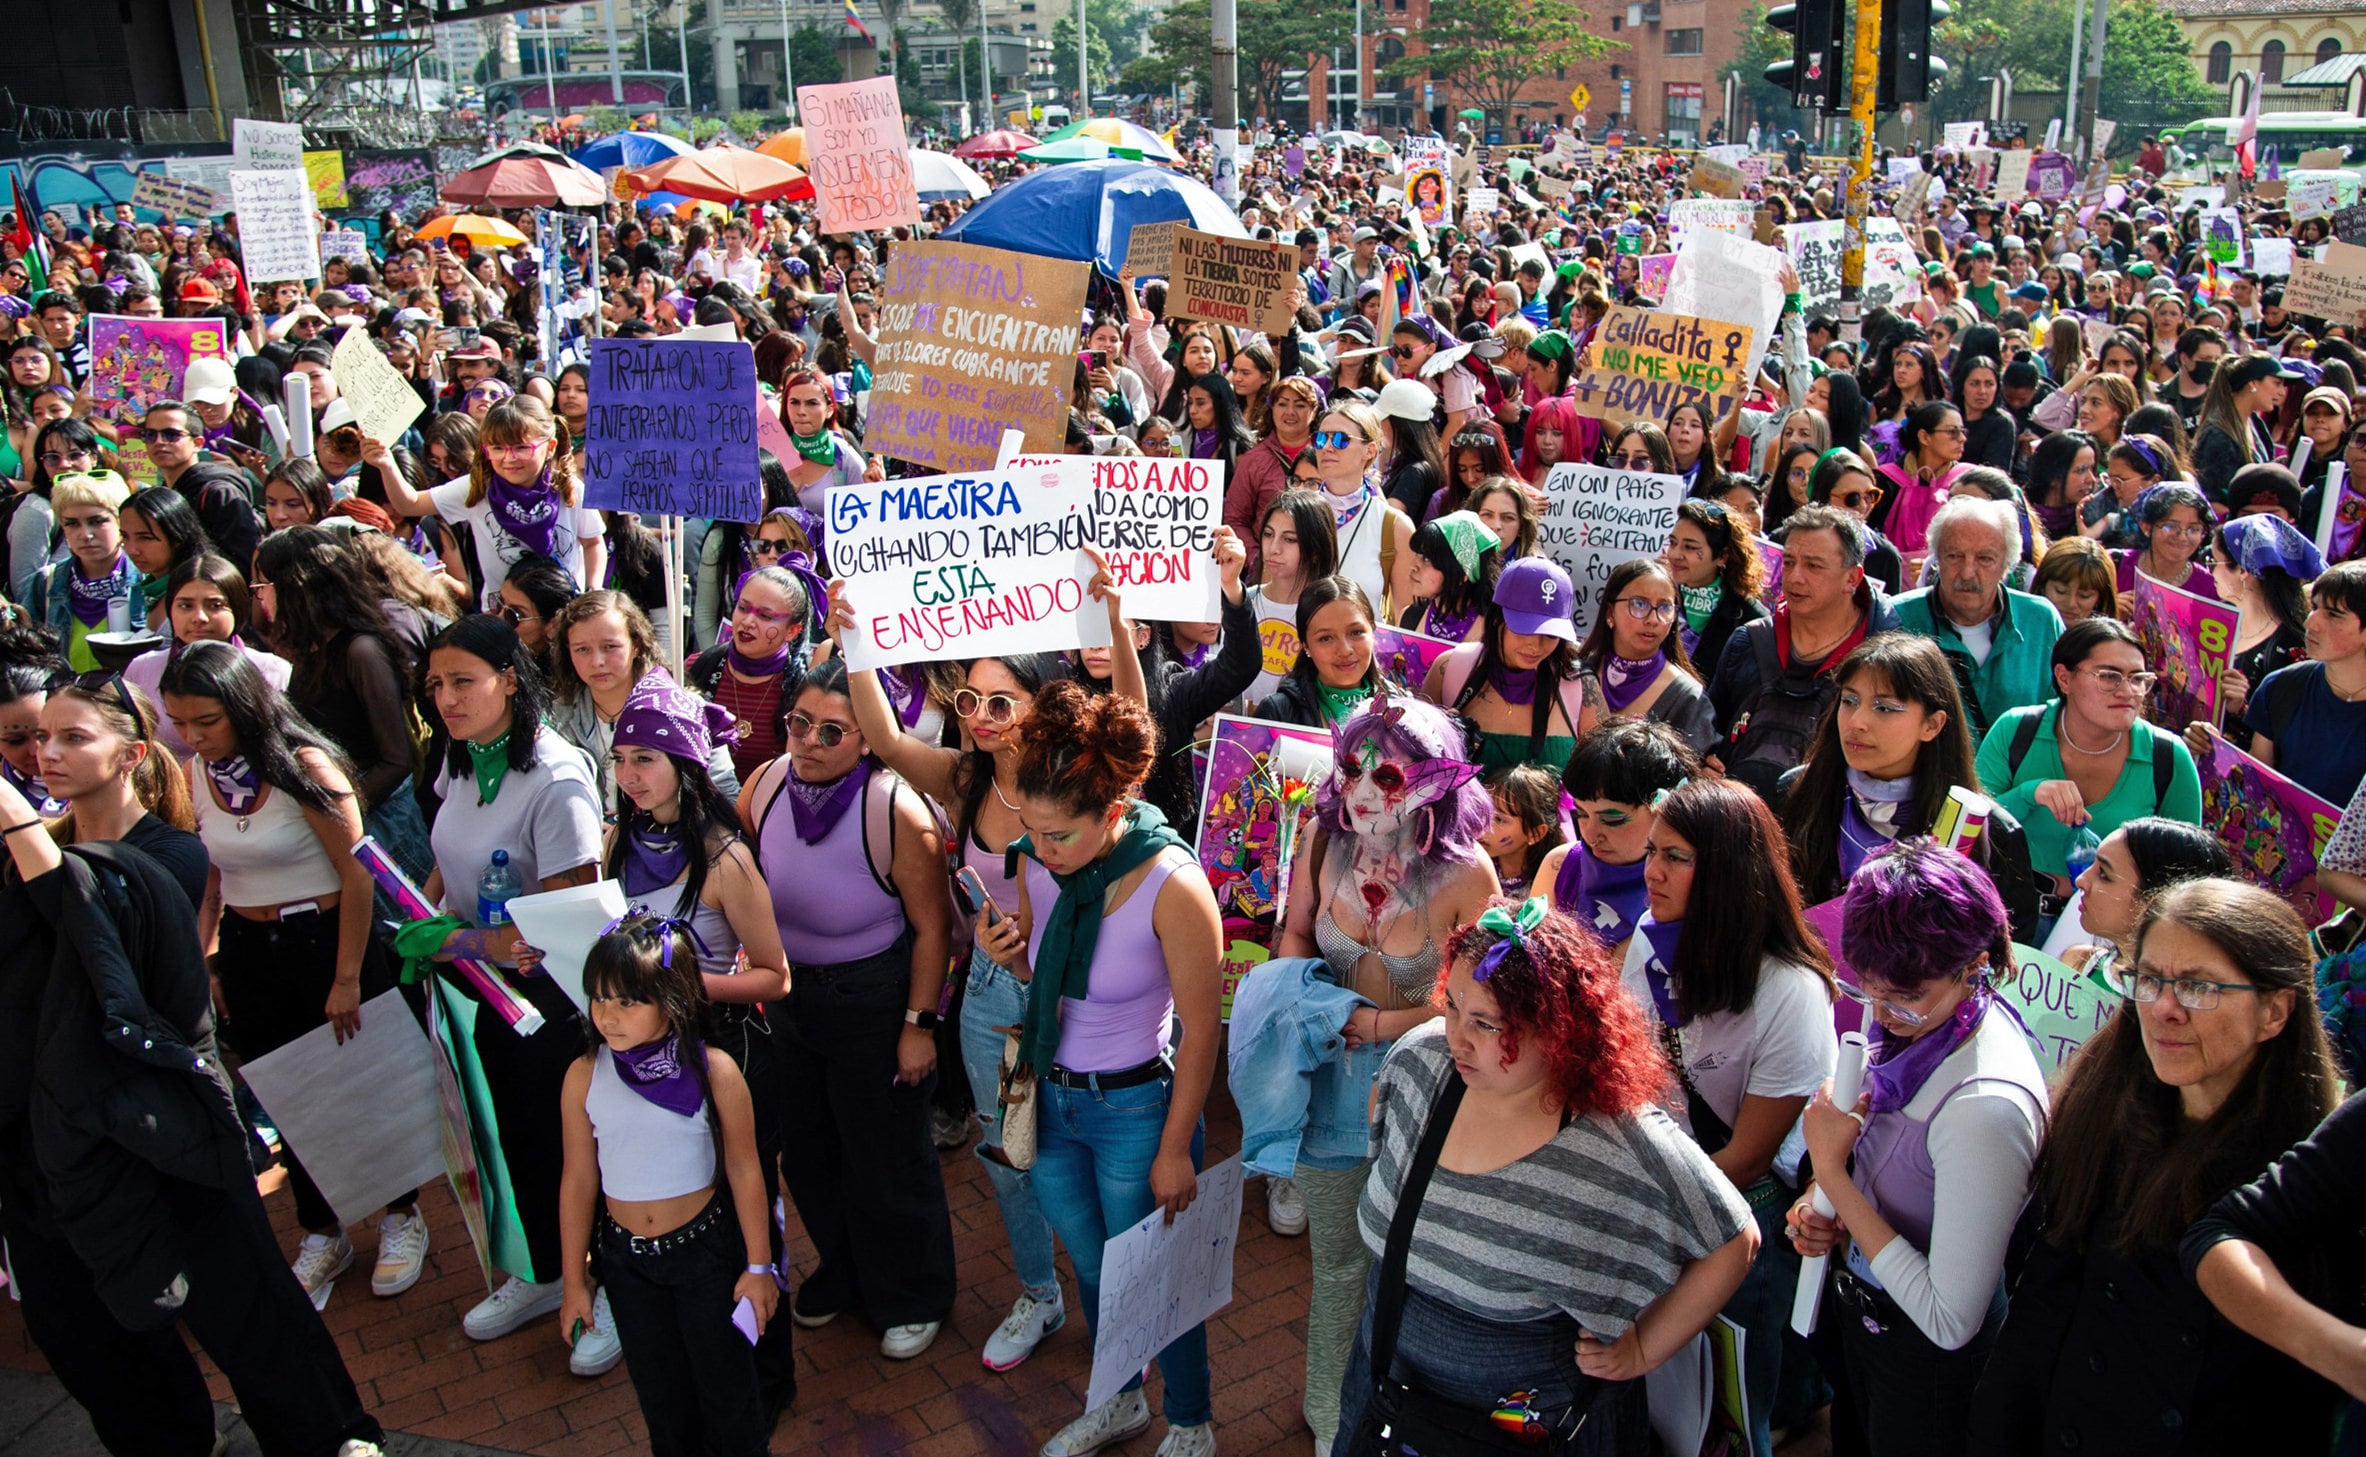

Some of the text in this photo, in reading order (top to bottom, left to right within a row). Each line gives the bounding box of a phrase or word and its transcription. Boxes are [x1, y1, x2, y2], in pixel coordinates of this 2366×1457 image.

[834, 90, 898, 125] MAÑANA
[825, 127, 878, 151] SOY YO
[1179, 237, 1292, 272] NI LAS MUJERES NI
[1185, 257, 1199, 276] LA
[1201, 261, 1240, 284] TIERRA
[1242, 270, 1282, 291] SOMOS
[1184, 278, 1272, 309] TERRITORIO DE
[1187, 298, 1249, 324] CONQUISTA
[190, 330, 220, 351] 8
[942, 306, 1078, 356] ENCUENTRAN
[1604, 312, 1713, 363] Calladita
[600, 343, 738, 392] TRATARON DE
[901, 340, 952, 368] FLORES
[1601, 347, 1724, 392] NO ME VEO
[921, 374, 942, 397] YO
[589, 403, 696, 442] ENTERRARNOS
[707, 402, 751, 444] PERO
[905, 407, 941, 439] QUE
[948, 412, 1024, 449] VIENE
[586, 452, 613, 480] NO
[690, 447, 724, 482] QUE
[1092, 460, 1139, 493] MOS
[1168, 460, 1209, 493] NO
[621, 481, 758, 523] ERAMOS SEMILLAS
[1549, 471, 1576, 492] EN
[1615, 474, 1665, 502] PAÍS
[832, 480, 1023, 535] LA MAESTRA
[1572, 500, 1676, 530] IGNORANTE
[831, 503, 1098, 579] LUCHANDO TAMBIÉN
[1097, 520, 1214, 552] ERSE DE
[1587, 526, 1665, 554] GRITAN
[913, 559, 997, 606] ESTÁ
[1104, 545, 1191, 587] ACIÓN
[871, 577, 1083, 653] ENSEÑANDO
[2198, 617, 2229, 653] 8
[2018, 962, 2082, 1021] QUÉ
